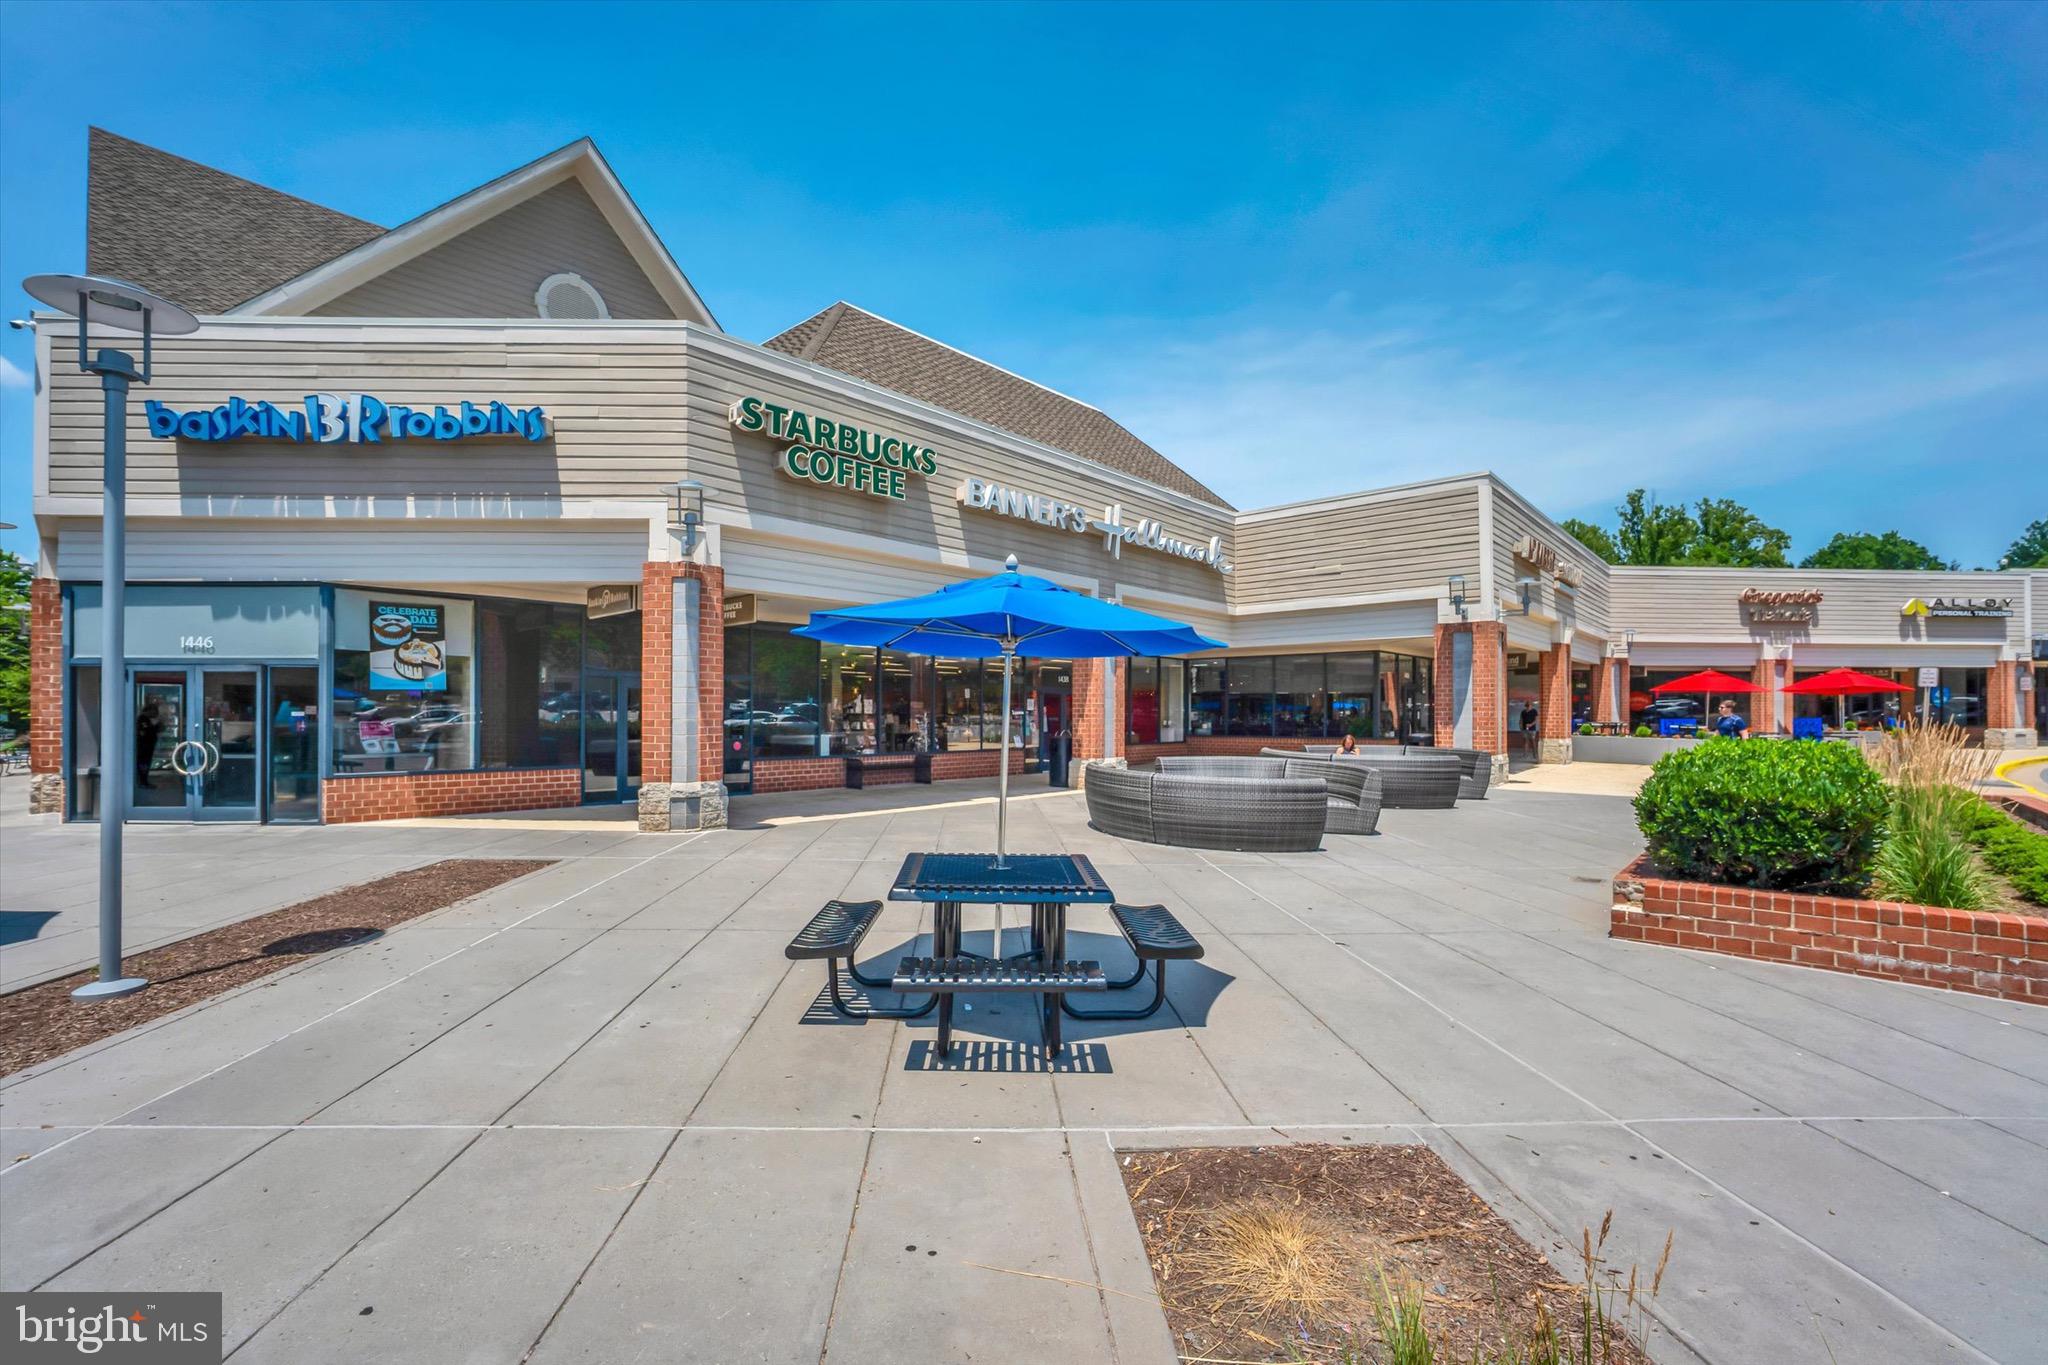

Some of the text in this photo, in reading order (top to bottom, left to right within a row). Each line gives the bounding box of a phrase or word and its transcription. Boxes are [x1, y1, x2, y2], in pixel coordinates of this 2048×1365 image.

[144, 396, 305, 442] baskin
[388, 400, 547, 442] robbins
[734, 396, 938, 477] STARBUCKS
[784, 444, 906, 500] COFFEE
[960, 478, 1234, 575] BANNER'S Hallmark
[1933, 598, 2013, 608] ALLOY
[378, 606, 437, 617] CELEBRATE
[1932, 609, 2013, 617] PERSONAL TRAINING
[409, 615, 437, 625] DAD
[180, 635, 214, 648] 1446
